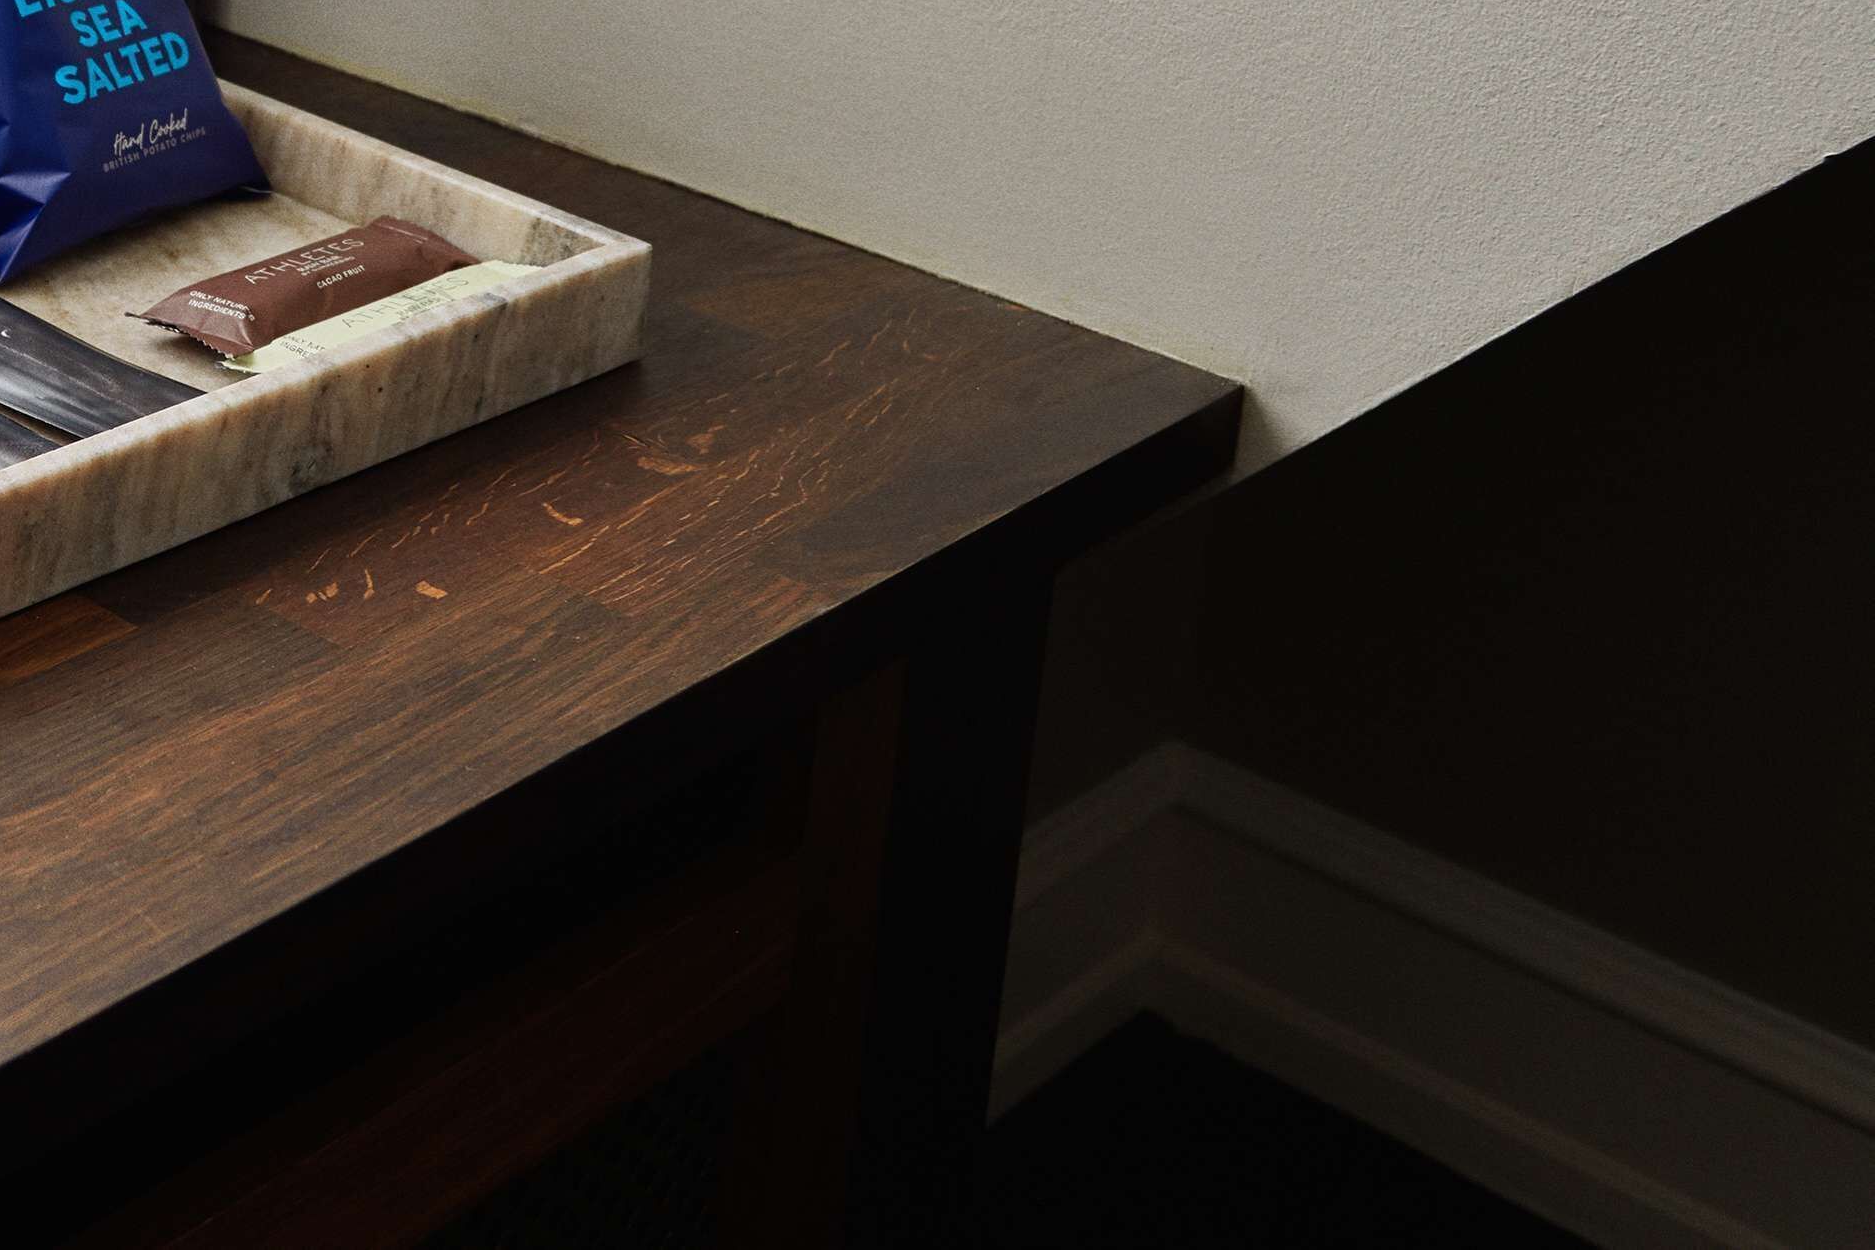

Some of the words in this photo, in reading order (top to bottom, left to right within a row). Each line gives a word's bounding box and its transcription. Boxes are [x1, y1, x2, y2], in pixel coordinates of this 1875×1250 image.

[70, 0, 147, 47] SEA
[54, 32, 190, 104] SALTED
[113, 122, 145, 156] Hand
[149, 107, 188, 144] Cooked
[143, 138, 177, 157] POTATO
[180, 127, 206, 143] CHIPS
[244, 238, 365, 286] ATHLETES
[316, 273, 343, 289] CACAO
[343, 264, 366, 278] FRUIT
[188, 300, 246, 320] INGREDIENTS
[189, 291, 213, 301] ONLY
